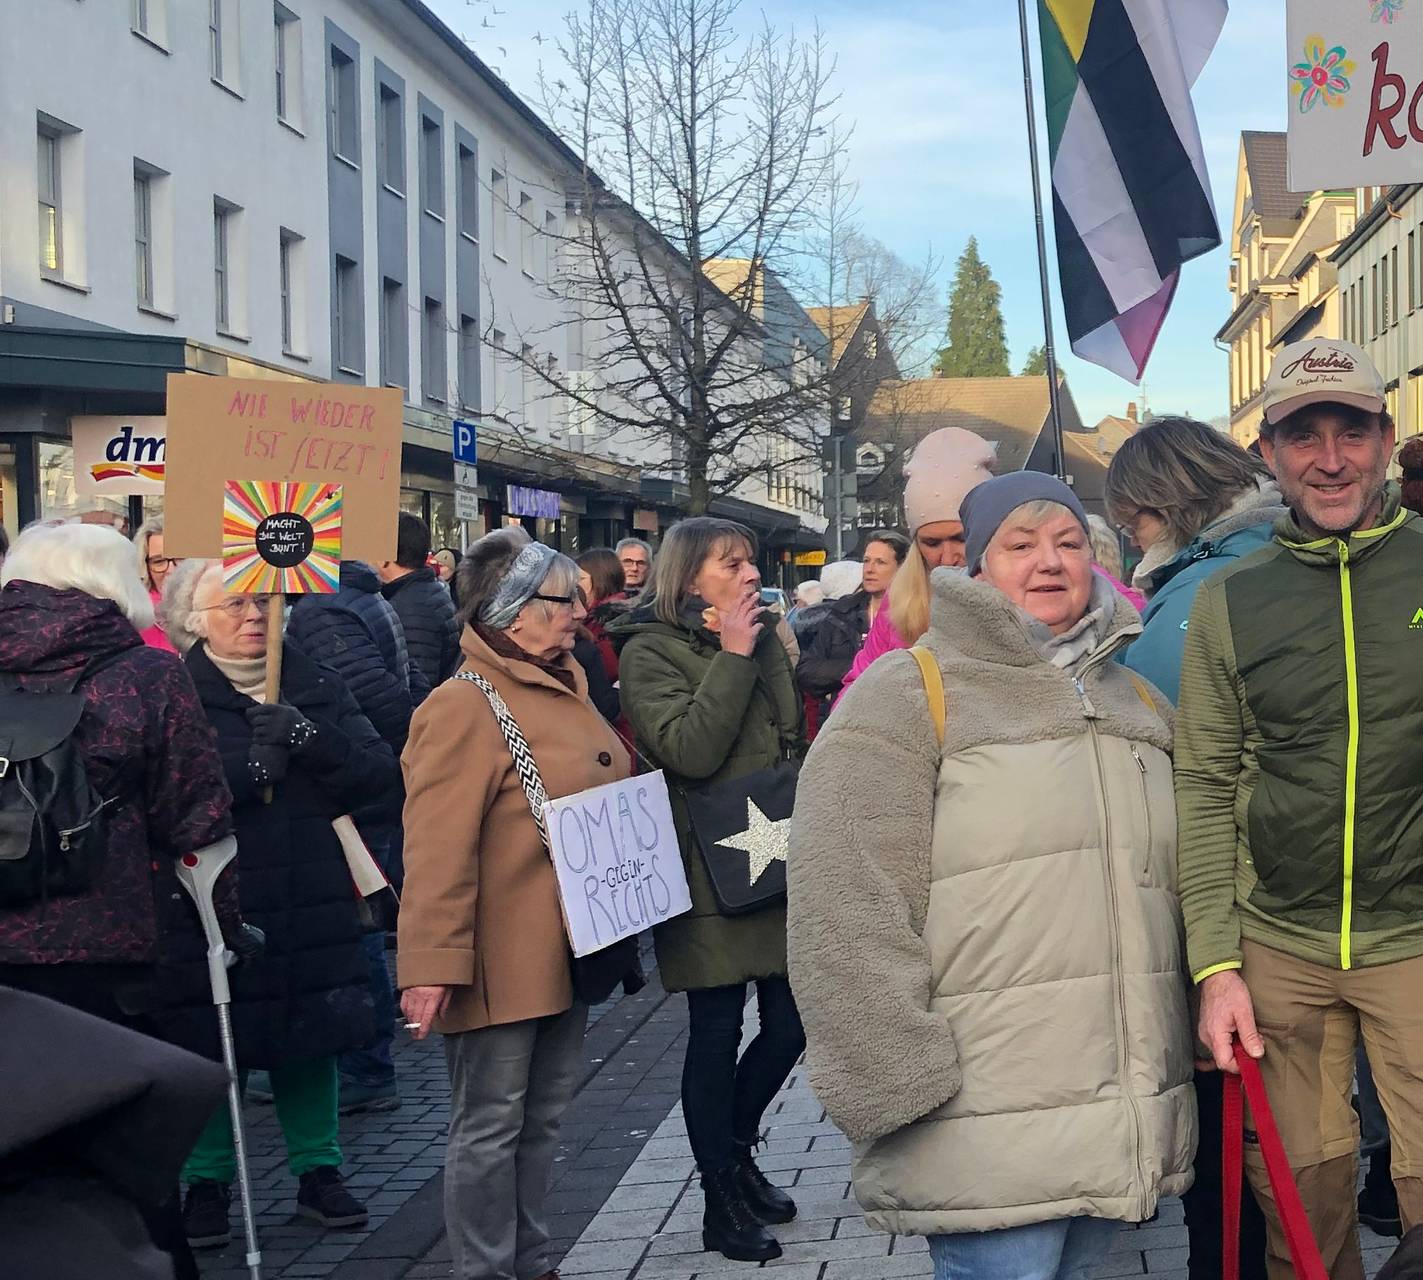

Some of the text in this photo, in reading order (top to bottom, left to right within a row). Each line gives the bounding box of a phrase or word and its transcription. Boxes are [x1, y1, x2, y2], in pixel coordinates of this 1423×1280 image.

[1281, 347, 1355, 379] Austria
[228, 390, 269, 418] NIE
[106, 426, 166, 462] dm
[458, 426, 471, 456] P
[266, 518, 301, 530] MACHT
[279, 531, 305, 541] WELT
[559, 786, 659, 874] OMAS
[584, 854, 671, 945] RECHTS
